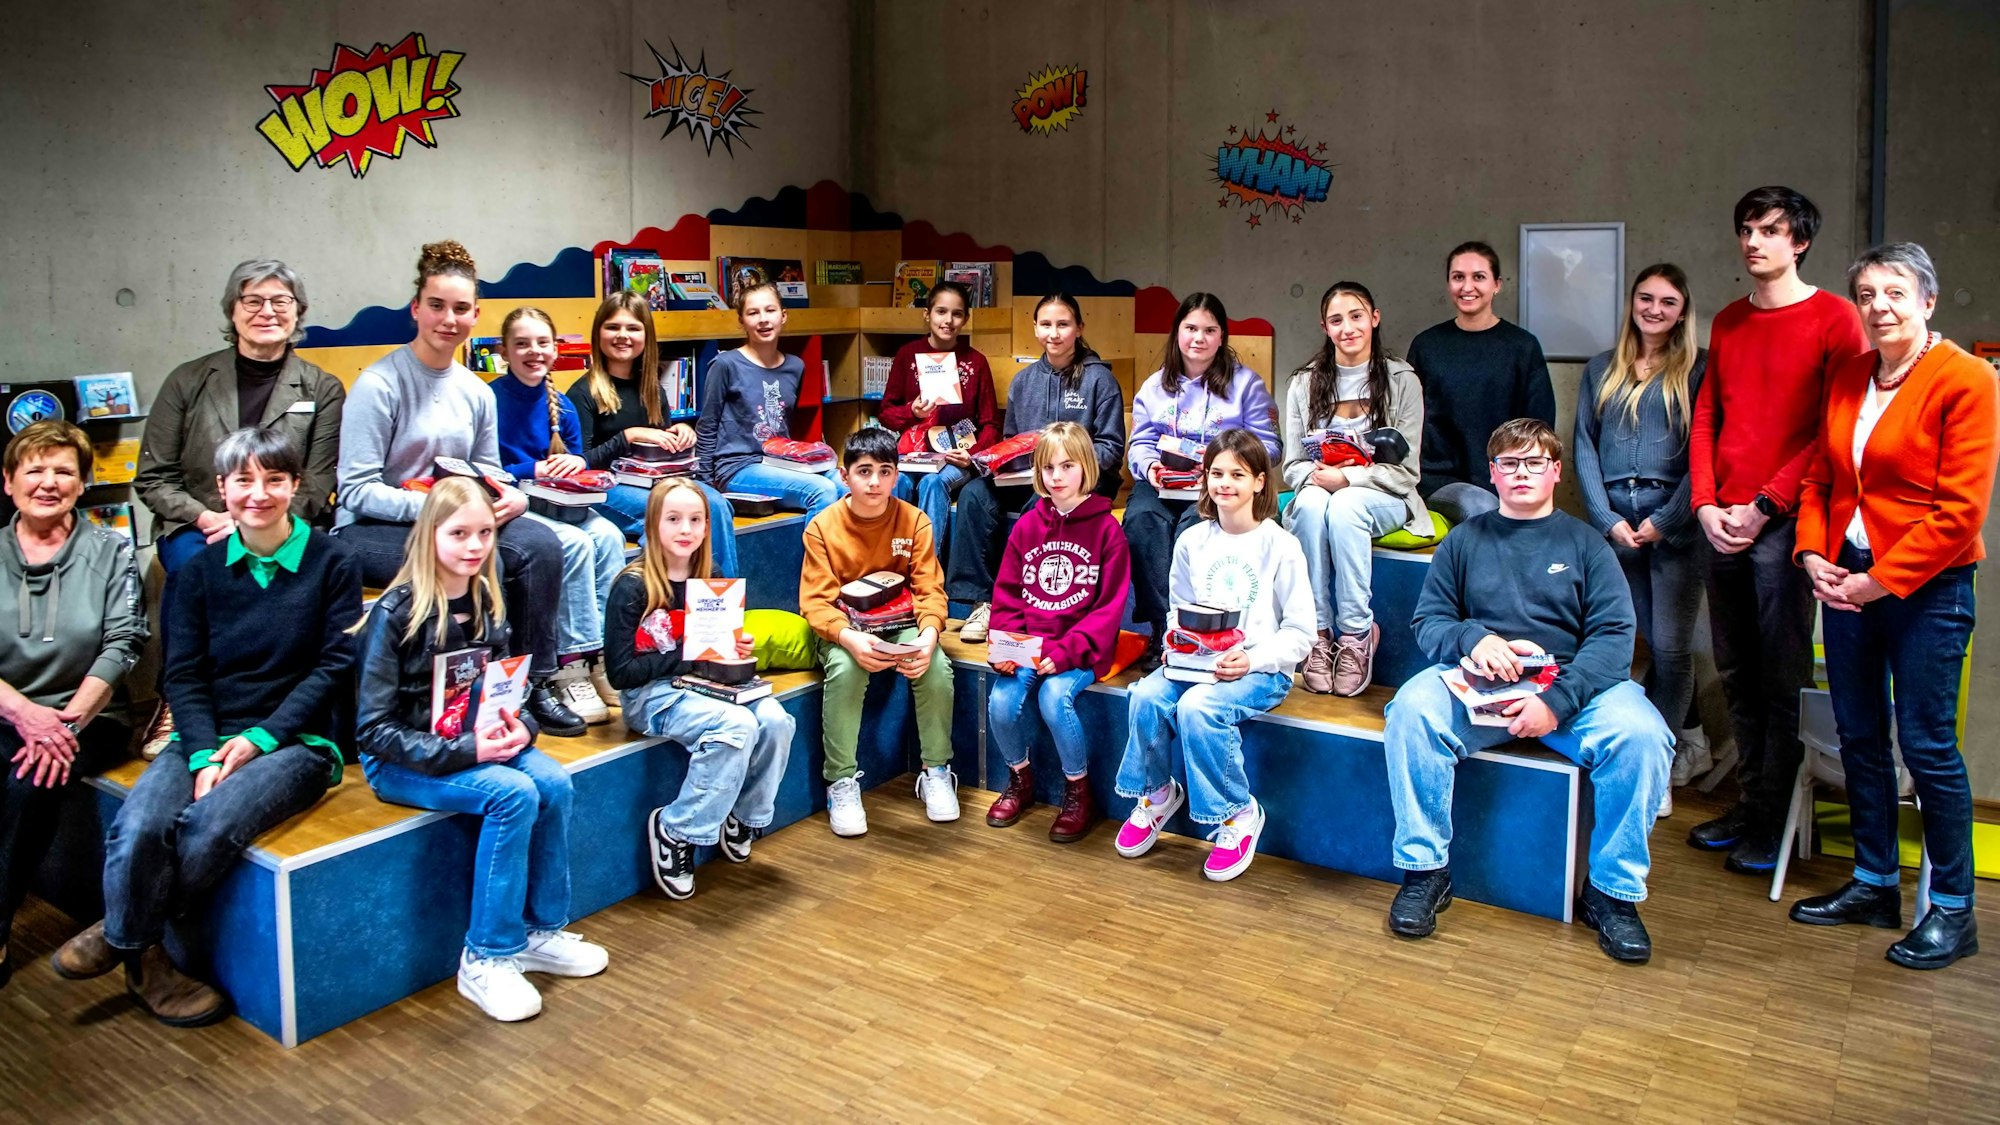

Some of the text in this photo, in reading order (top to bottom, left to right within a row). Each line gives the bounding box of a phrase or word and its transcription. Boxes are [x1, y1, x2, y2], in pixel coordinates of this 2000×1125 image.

[256, 51, 466, 172] WOW!
[650, 74, 749, 131] NICE!
[1012, 69, 1088, 133] POW!
[1217, 145, 1334, 202] WHAM!
[1024, 541, 1092, 563] ST. MICHAEL
[1073, 564, 1101, 585] 25
